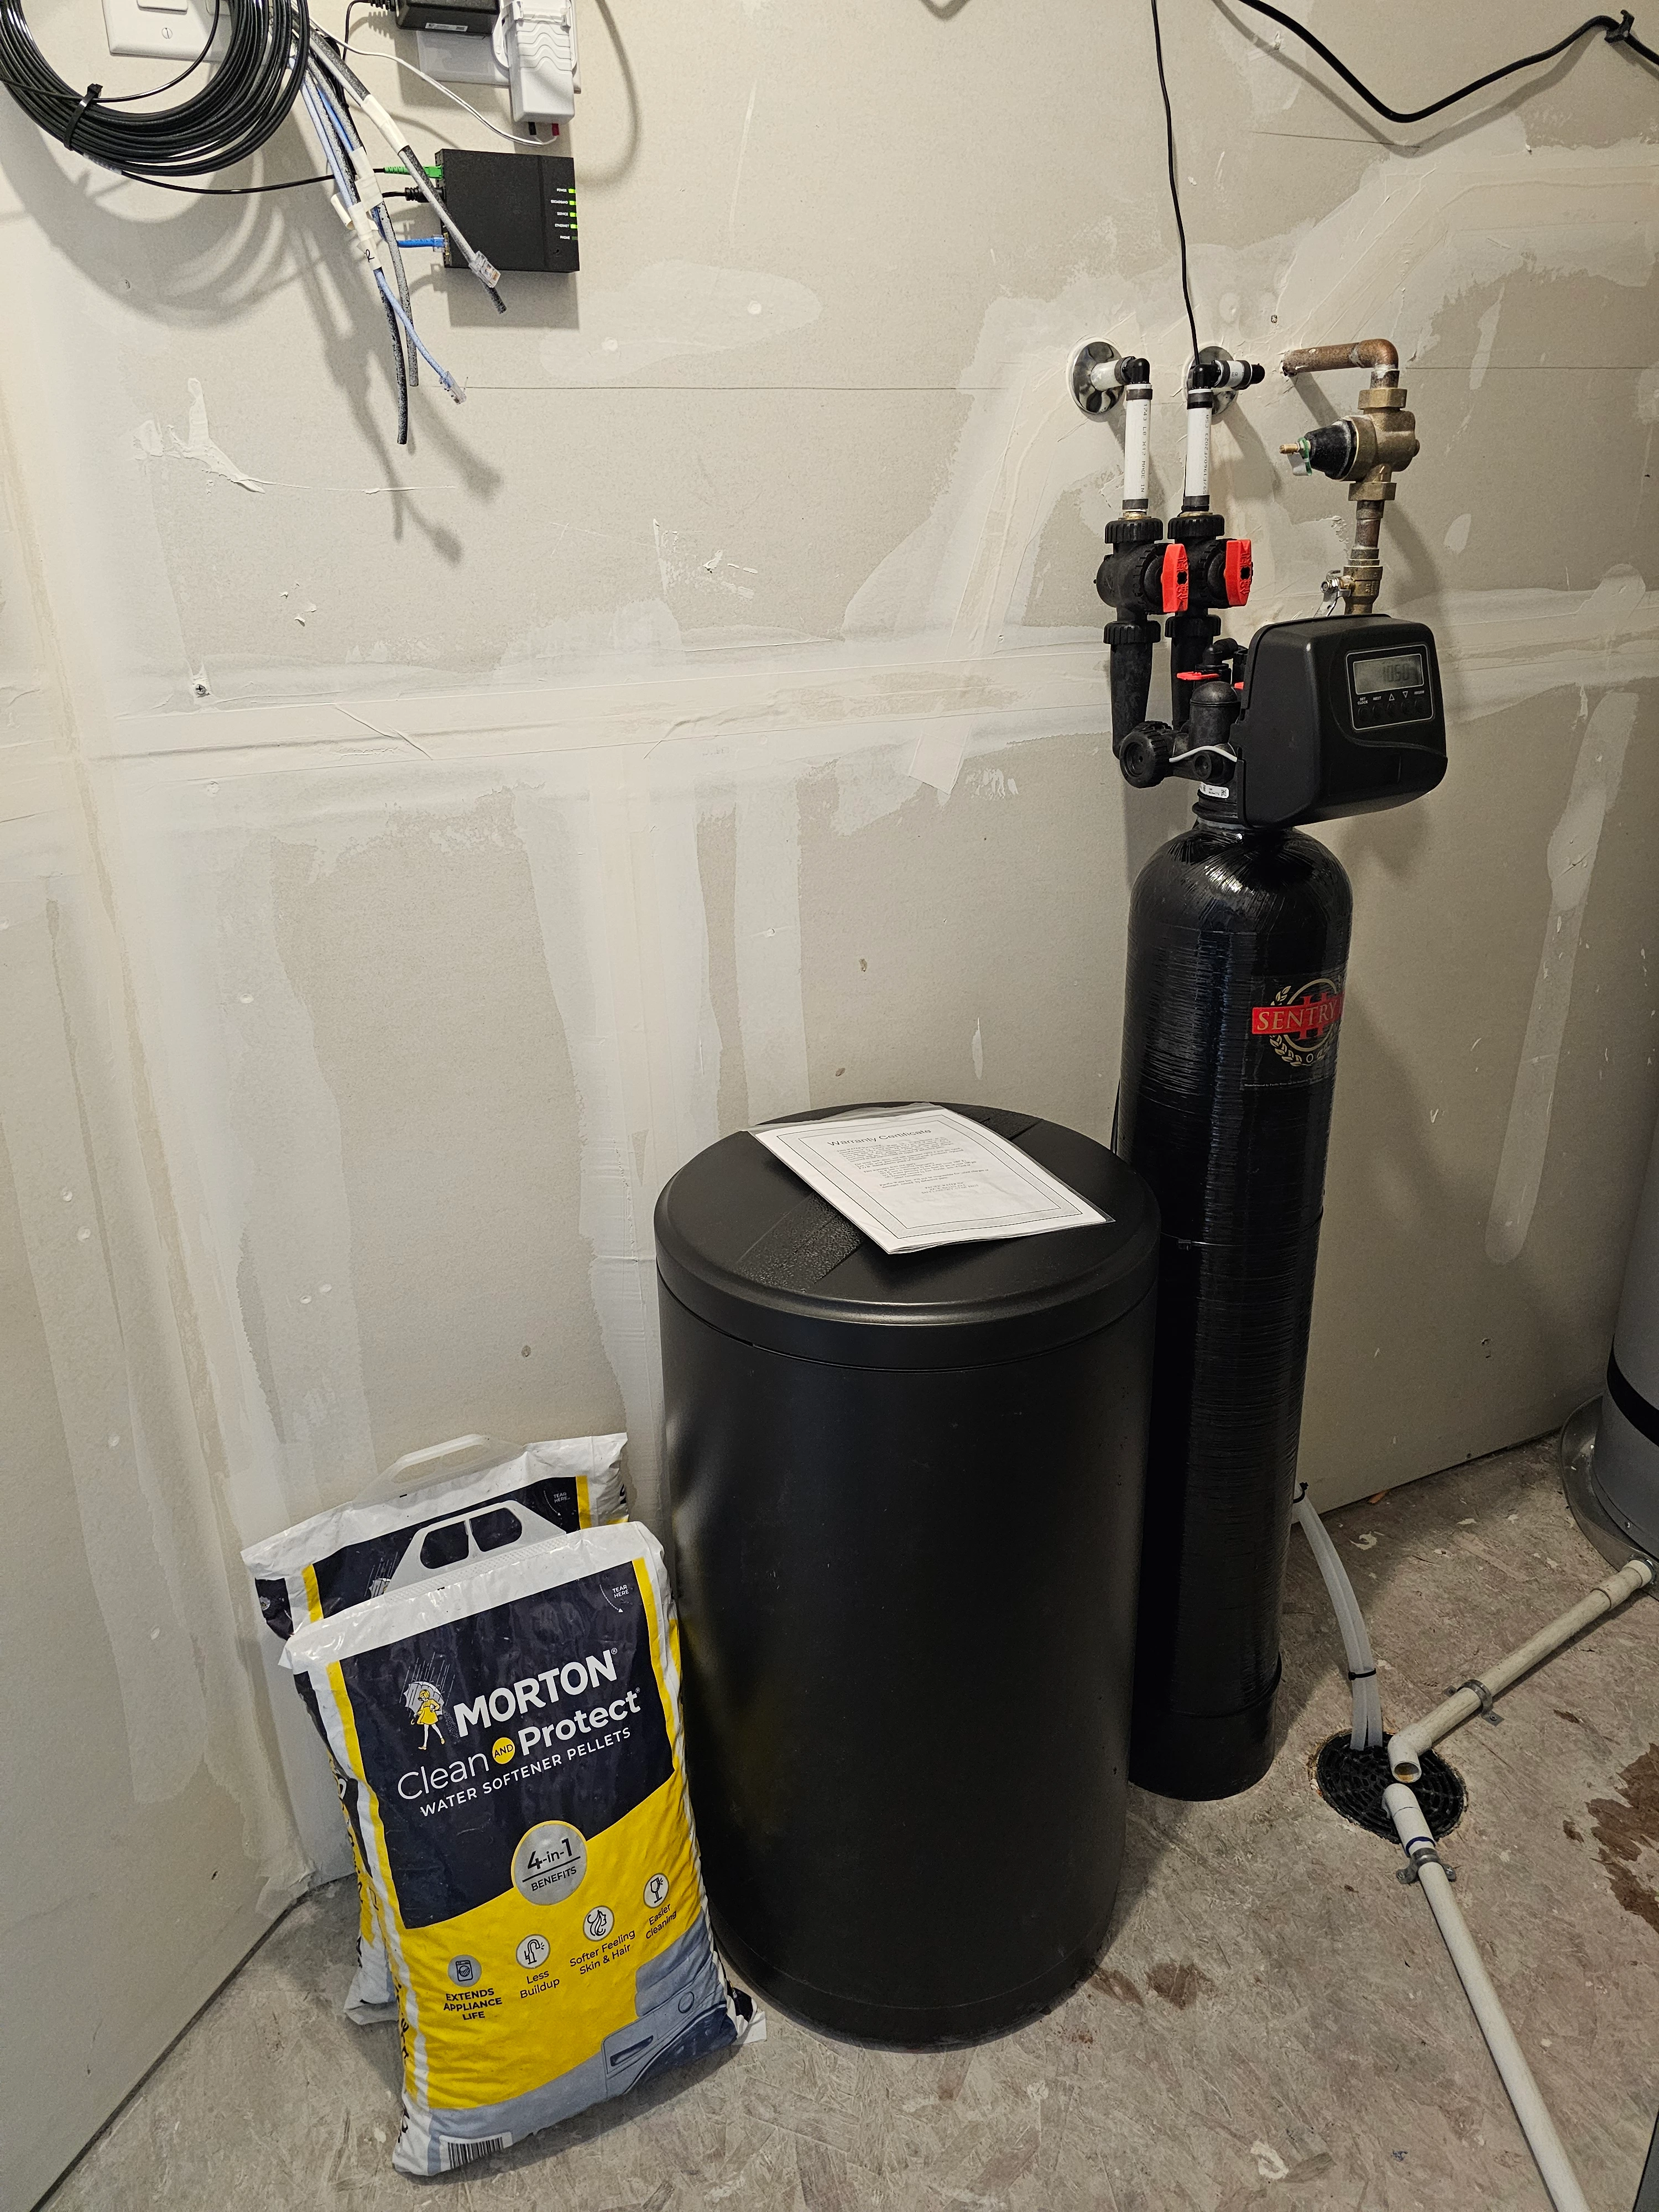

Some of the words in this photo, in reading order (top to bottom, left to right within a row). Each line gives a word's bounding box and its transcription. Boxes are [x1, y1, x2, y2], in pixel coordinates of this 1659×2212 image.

[1141, 484, 1145, 493] IN
[1257, 999, 1338, 1031] SENTRY
[827, 1137, 877, 1146] Warranty
[879, 1129, 931, 1140] Certificate
[612, 1584, 628, 1593] TEAR
[614, 1589, 629, 1598] HERE
[453, 1649, 618, 1738] MORTON
[398, 1752, 489, 1799] Clean
[494, 1743, 514, 1757] AND
[518, 1689, 640, 1756] Protect
[420, 1787, 477, 1817] WATER
[483, 1752, 562, 1794] SOFTENER
[567, 1727, 631, 1761] PELLETS
[527, 1838, 573, 1870] 4-in-1
[531, 1866, 577, 1891] BENEFITS
[645, 1910, 677, 1939] Cleaning
[648, 1903, 671, 1926] Easier
[570, 1946, 599, 1968] Softer
[602, 1930, 635, 1953] Feeling
[580, 1960, 601, 1975] Skin
[603, 1955, 610, 1963] &
[612, 1943, 631, 1958] Hair
[520, 1978, 560, 1999] Buildup
[526, 1970, 550, 1985] Less
[443, 1996, 502, 2012] APPLIANCE
[446, 1988, 494, 2001] EXTENDS
[462, 2010, 486, 2021] LIFE
